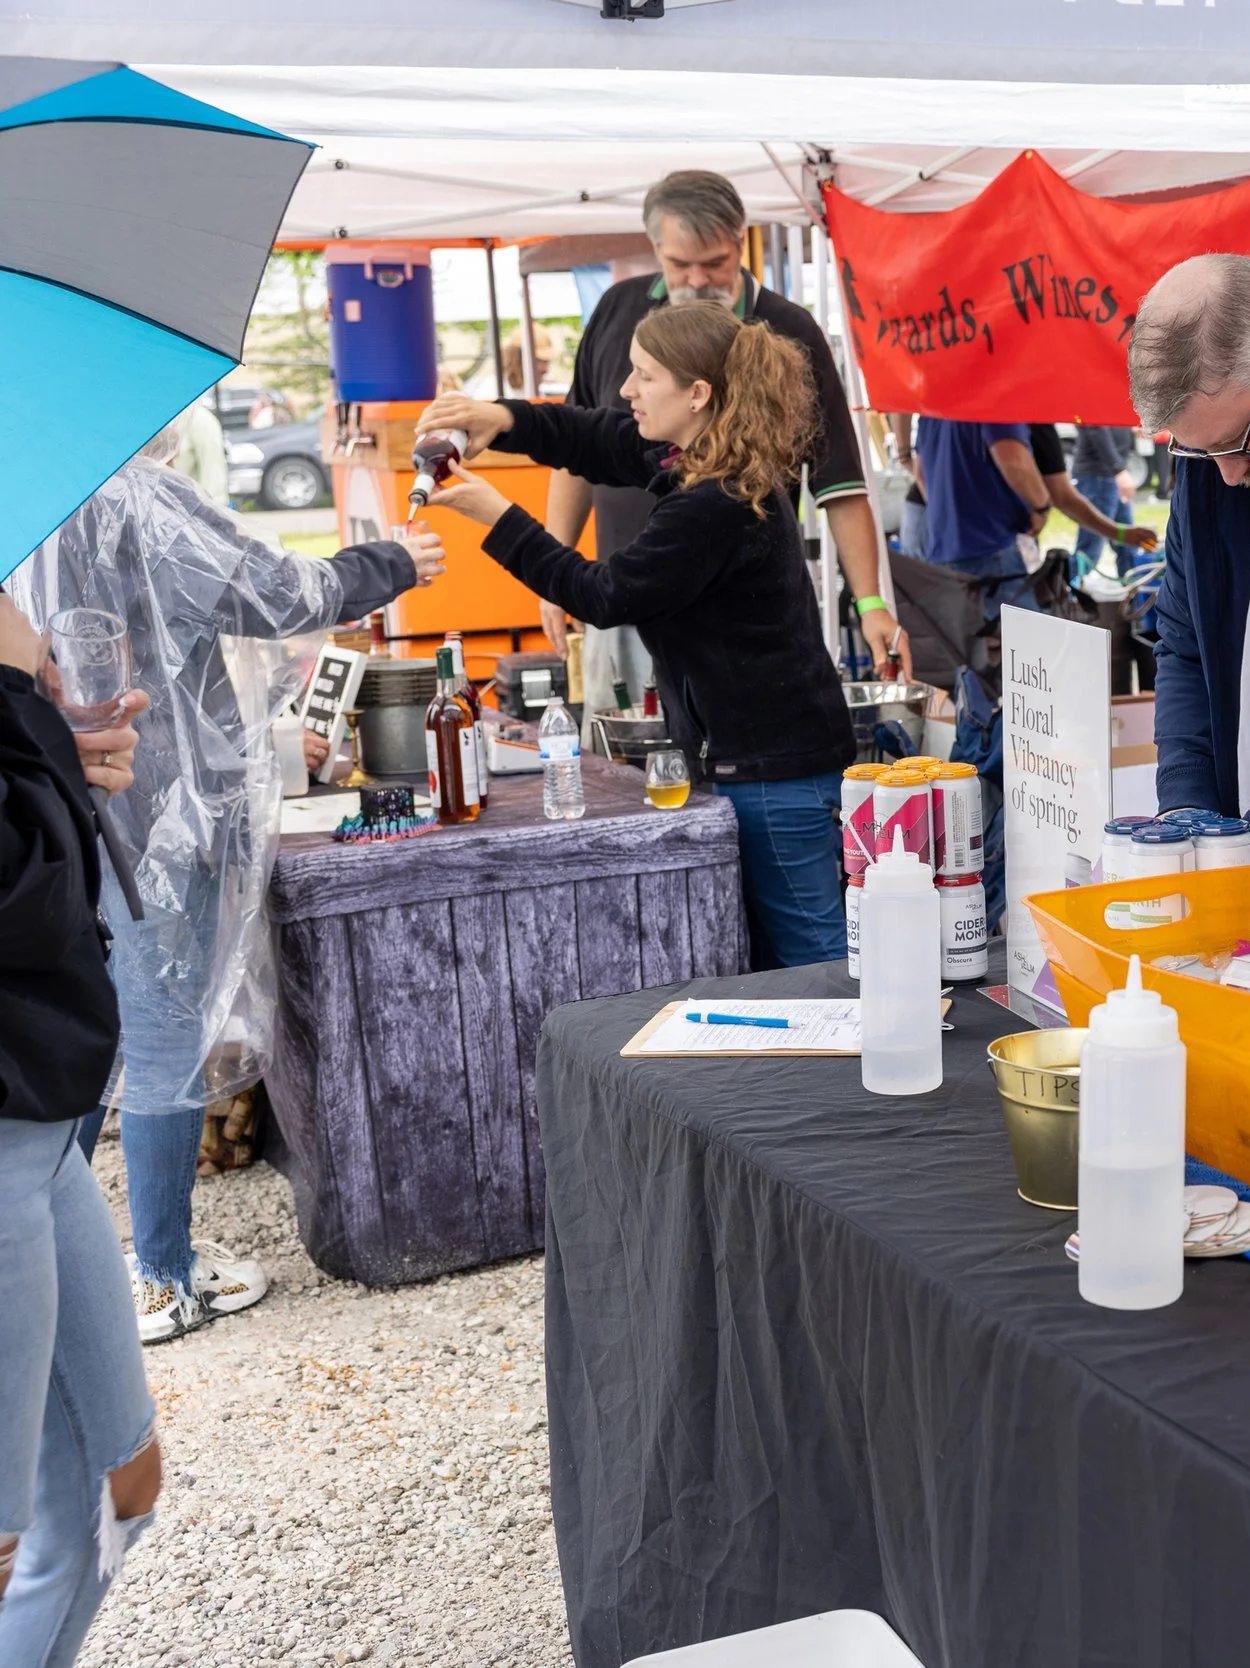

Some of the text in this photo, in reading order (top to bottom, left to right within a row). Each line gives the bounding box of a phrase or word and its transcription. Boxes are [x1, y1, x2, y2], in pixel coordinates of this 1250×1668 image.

[1001, 253, 1136, 345] Wines,
[1010, 648, 1052, 693] Lush.
[1011, 691, 1058, 739] Floral.
[1010, 733, 1077, 798] Vibrancy
[1012, 780, 1027, 812] of
[1029, 793, 1081, 844] spring.
[954, 917, 985, 931] CIDER
[946, 956, 973, 965] Obscura
[1014, 1069, 1080, 1104] TIPS
